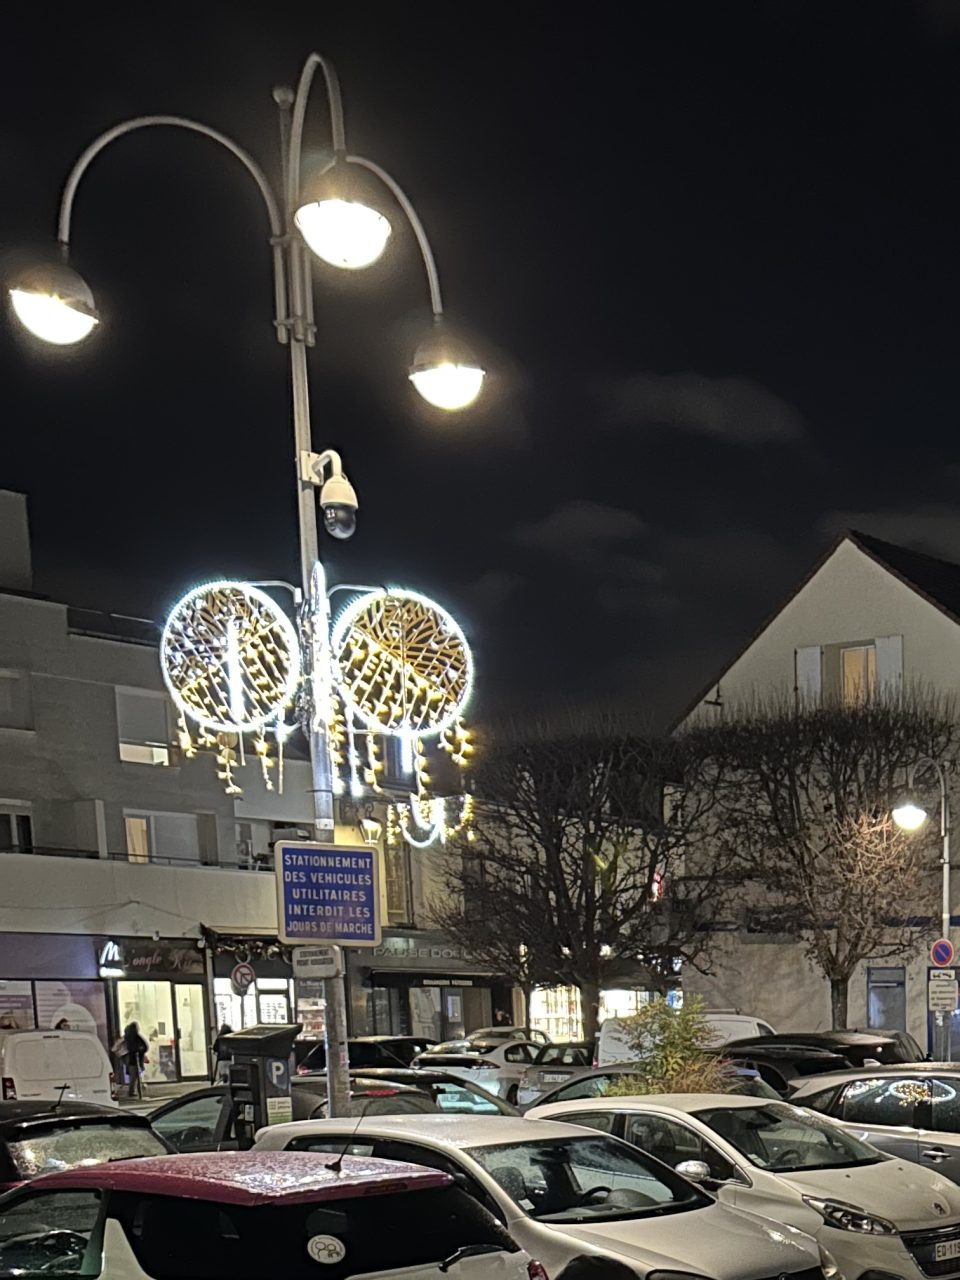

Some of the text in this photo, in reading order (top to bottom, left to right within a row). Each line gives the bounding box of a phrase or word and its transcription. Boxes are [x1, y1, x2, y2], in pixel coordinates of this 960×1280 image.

[284, 854, 371, 869] STATIONNEMENT
[284, 871, 372, 885] DES VEHICULES
[292, 888, 367, 902] UTILITAIRES
[288, 904, 371, 918] INTERDIT LES
[287, 921, 373, 934] JOURS DE MARCHE
[271, 1062, 285, 1085] P
